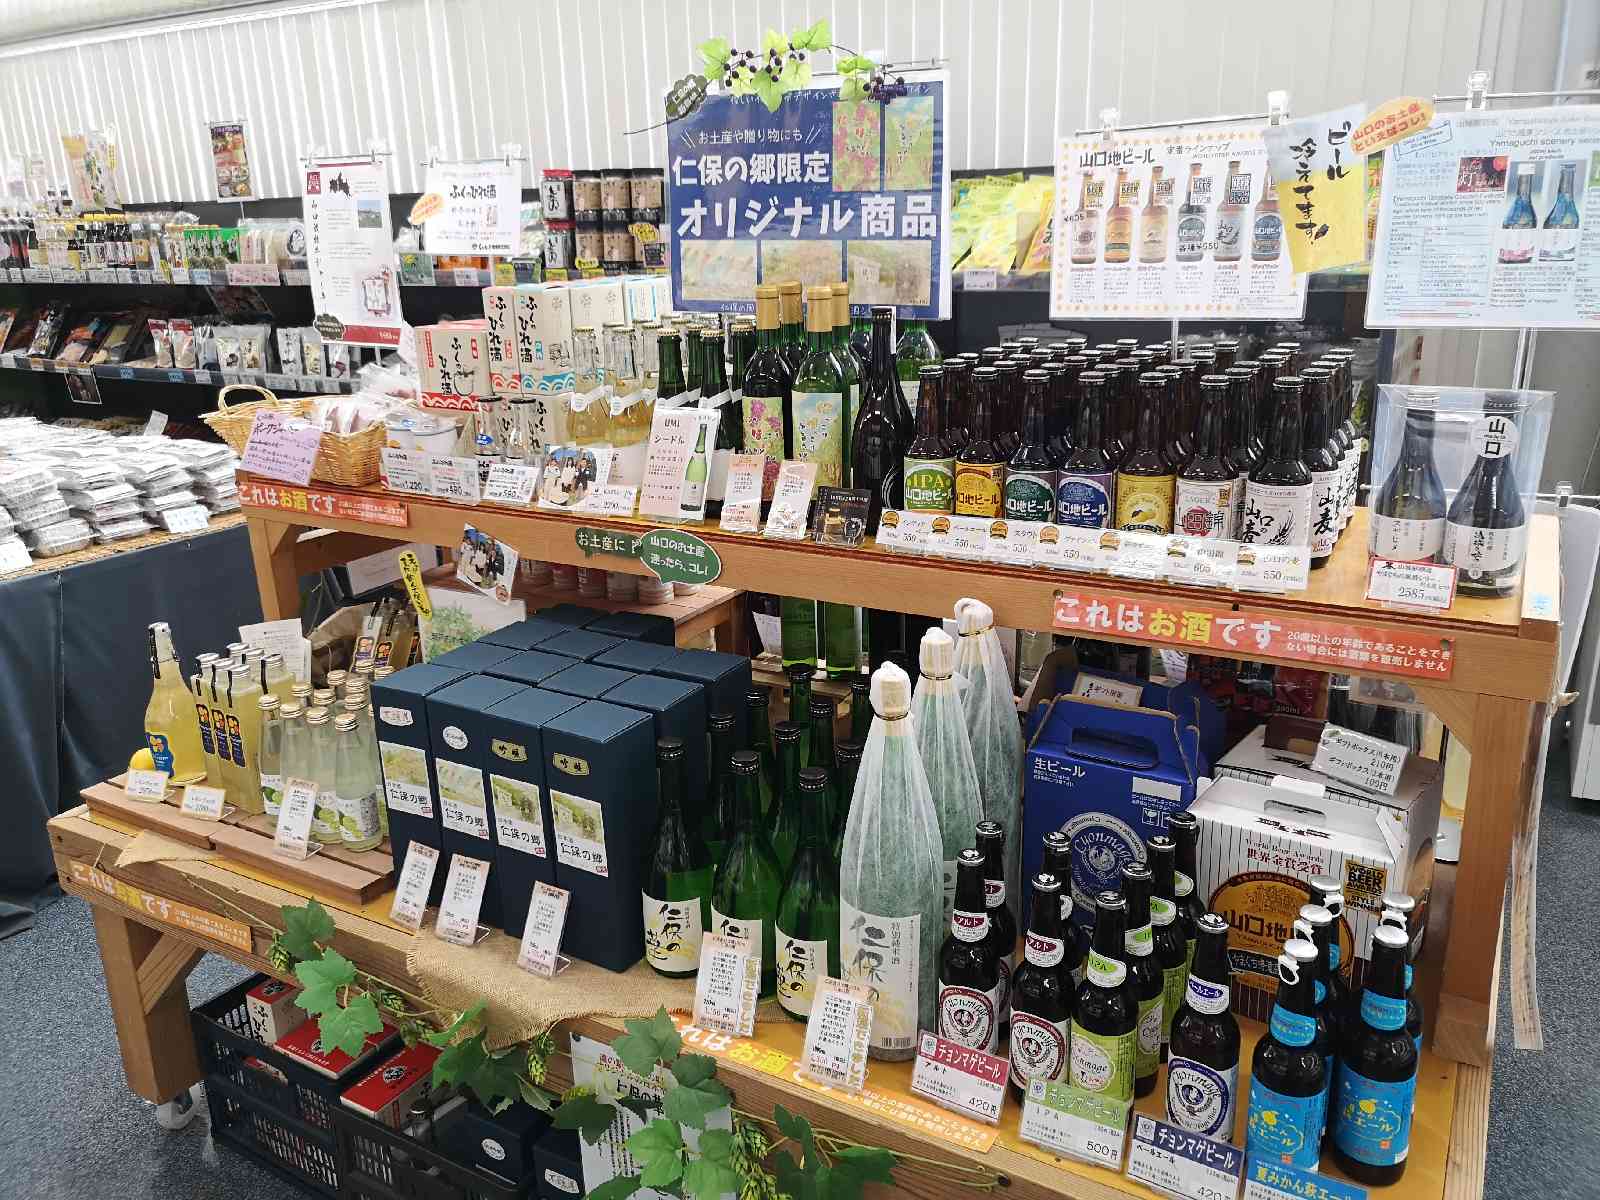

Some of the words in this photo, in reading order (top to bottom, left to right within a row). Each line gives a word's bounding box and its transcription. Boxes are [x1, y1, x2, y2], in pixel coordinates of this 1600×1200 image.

[698, 130, 804, 146] お土産や贈り物にも
[1079, 149, 1155, 168] 山口地ビール
[1326, 120, 1351, 180] ビール
[671, 150, 831, 187] 仁保の郷限定
[677, 195, 938, 238] オリジナル商品
[911, 474, 945, 489] IPA
[239, 486, 337, 514] これはお酒です
[578, 530, 625, 551] お土産に
[650, 535, 706, 558] 山口のお土産
[1263, 569, 1282, 581] 550
[1398, 586, 1425, 600] 2585
[1055, 595, 1282, 650] これはお酒です
[1033, 757, 1086, 778] 生ビール
[445, 807, 485, 828] 仁保の郷
[501, 825, 541, 846] 仁保の郷
[560, 842, 603, 863] 仁保の郷
[1346, 864, 1385, 880] WORLD
[1348, 872, 1382, 889] BEER
[1345, 900, 1383, 913] WINNER
[1351, 895, 1376, 905] STYLE
[957, 915, 979, 927] アルト
[938, 1044, 1001, 1079] チョンマゲビール
[1048, 1088, 1120, 1122] チョンマゲビール
[1086, 1140, 1119, 1161] 500円
[1136, 1143, 1176, 1165] ペールエール
[1158, 1128, 1235, 1169] チョンマゲビール
